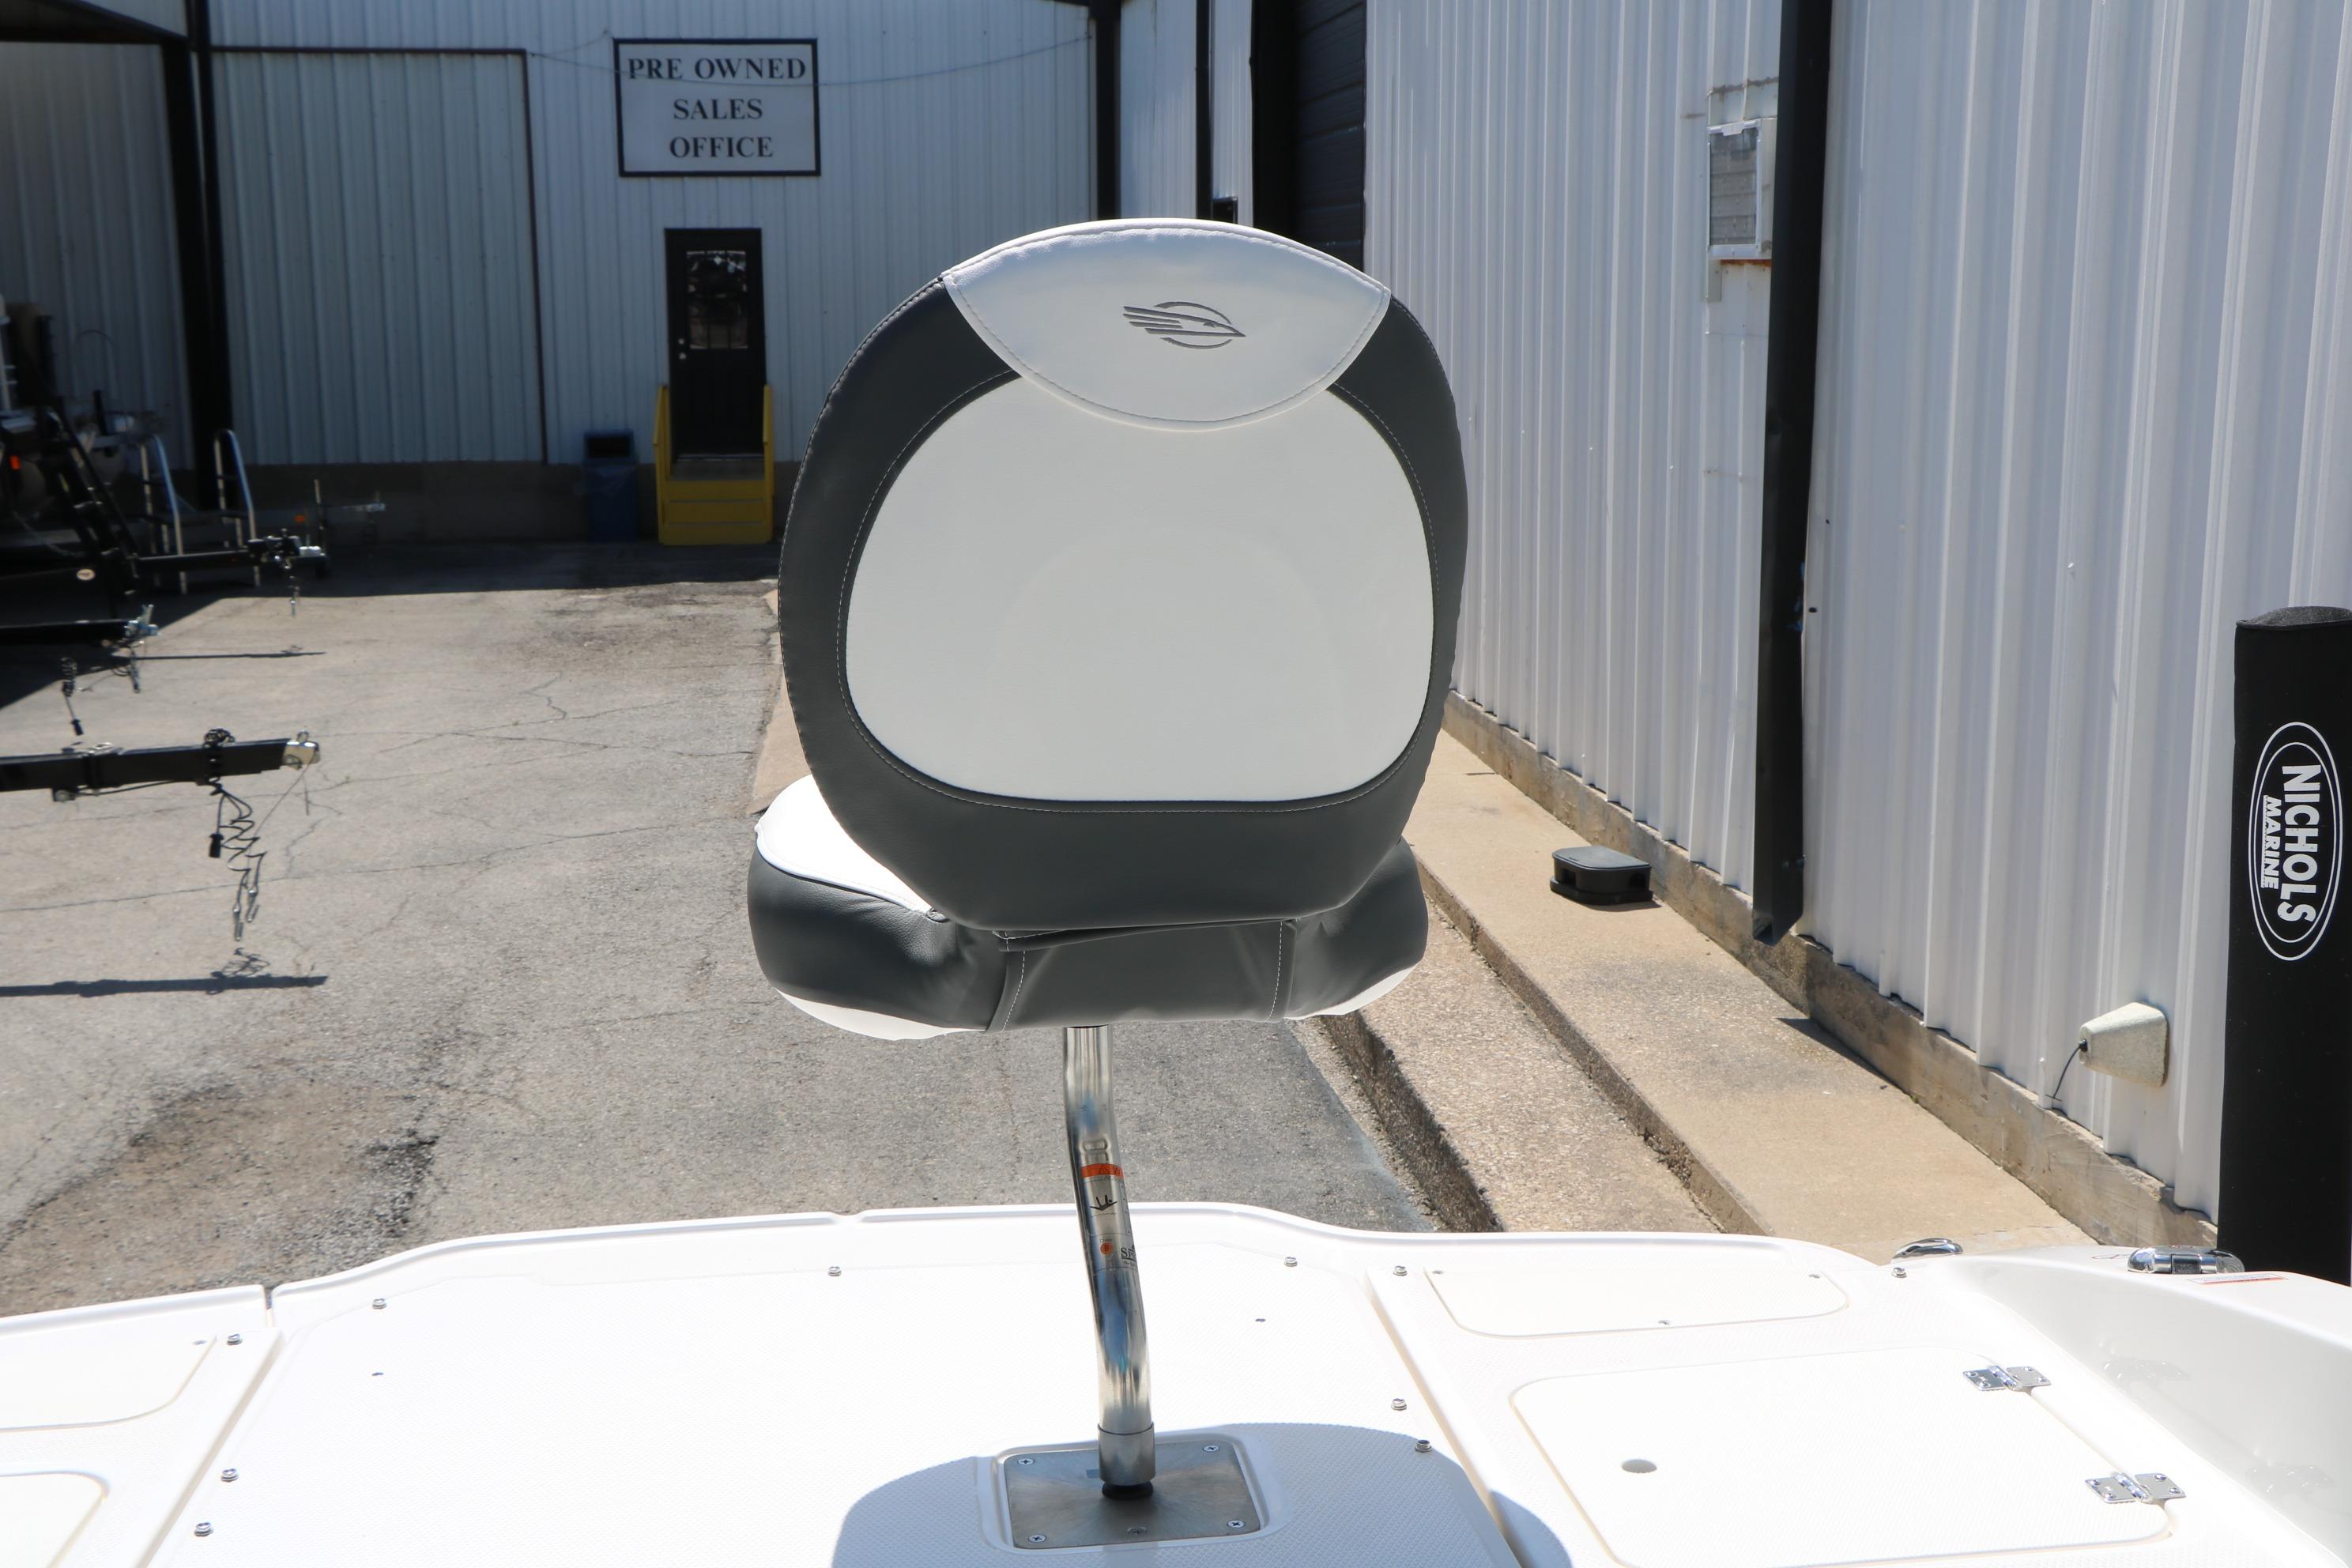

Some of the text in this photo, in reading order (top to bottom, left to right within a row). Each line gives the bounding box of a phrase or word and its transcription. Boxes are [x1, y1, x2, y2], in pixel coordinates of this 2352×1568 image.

[628, 58, 806, 79] PRE OWNED
[673, 99, 763, 119] SALES
[669, 136, 774, 157] OFFICE
[2261, 795, 2282, 890] MARINE
[2277, 764, 2321, 923] NICHOLS
